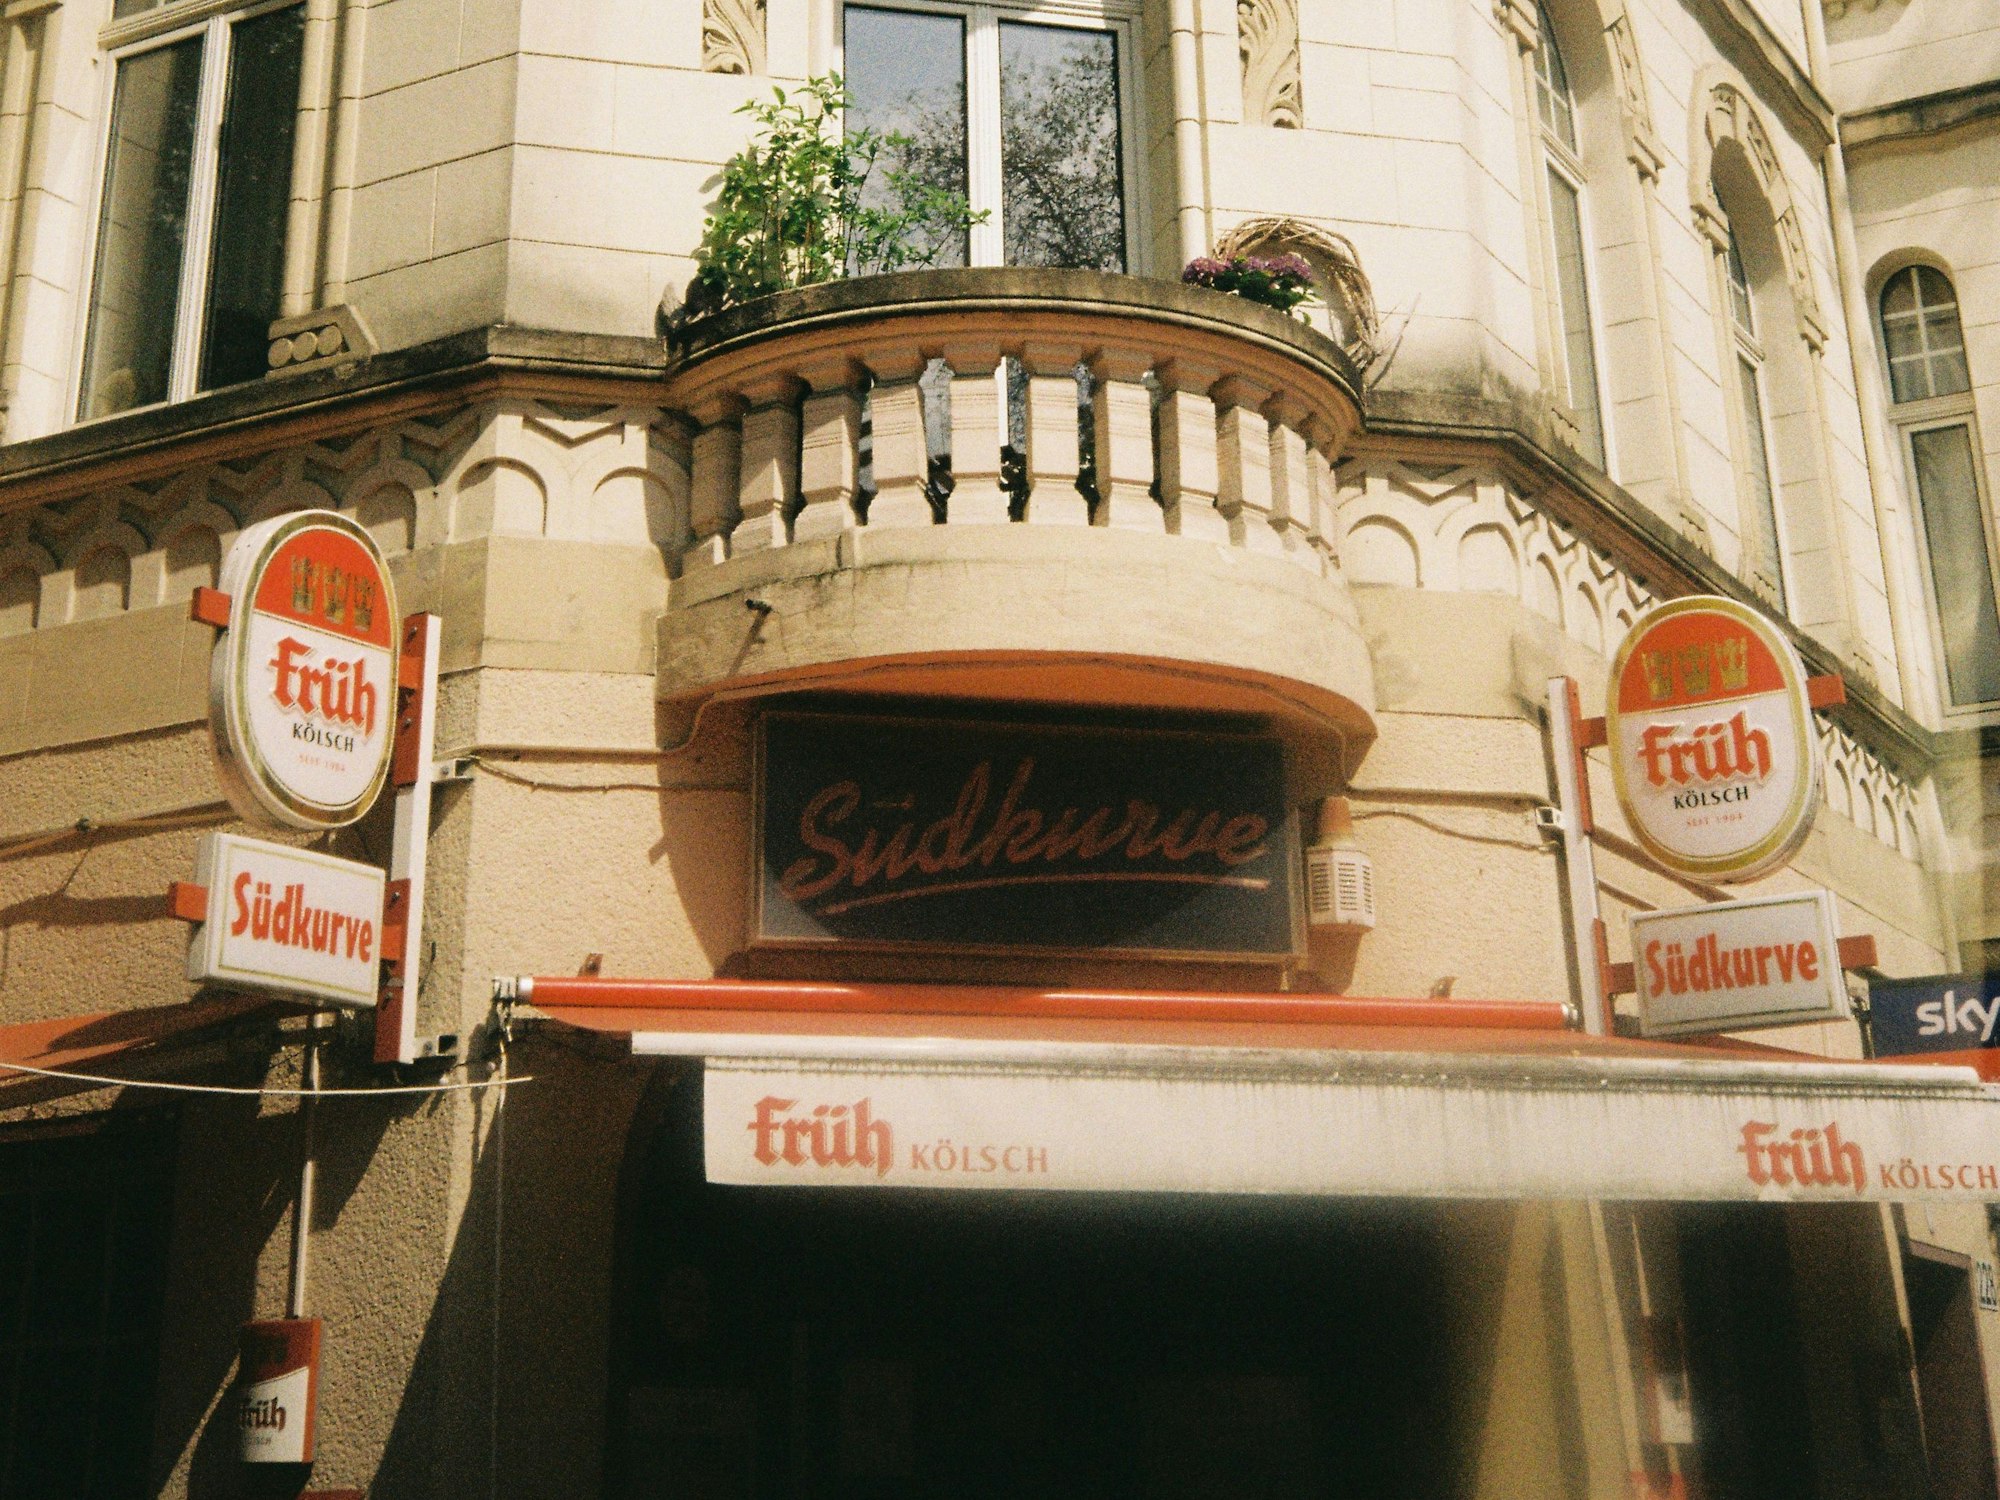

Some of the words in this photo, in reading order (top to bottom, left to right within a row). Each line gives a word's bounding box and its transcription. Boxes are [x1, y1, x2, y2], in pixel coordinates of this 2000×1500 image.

[293, 721, 355, 752] KÖLSCH
[1673, 785, 1750, 810] KÖLSCH
[778, 756, 1272, 901] Südkurve
[230, 871, 373, 963] Südkurve
[1645, 932, 1819, 998] Südkurve
[1915, 990, 2000, 1043] sky
[911, 1139, 1049, 1173] KÖLSCH
[1879, 1158, 1999, 1190] KÖLSCH
